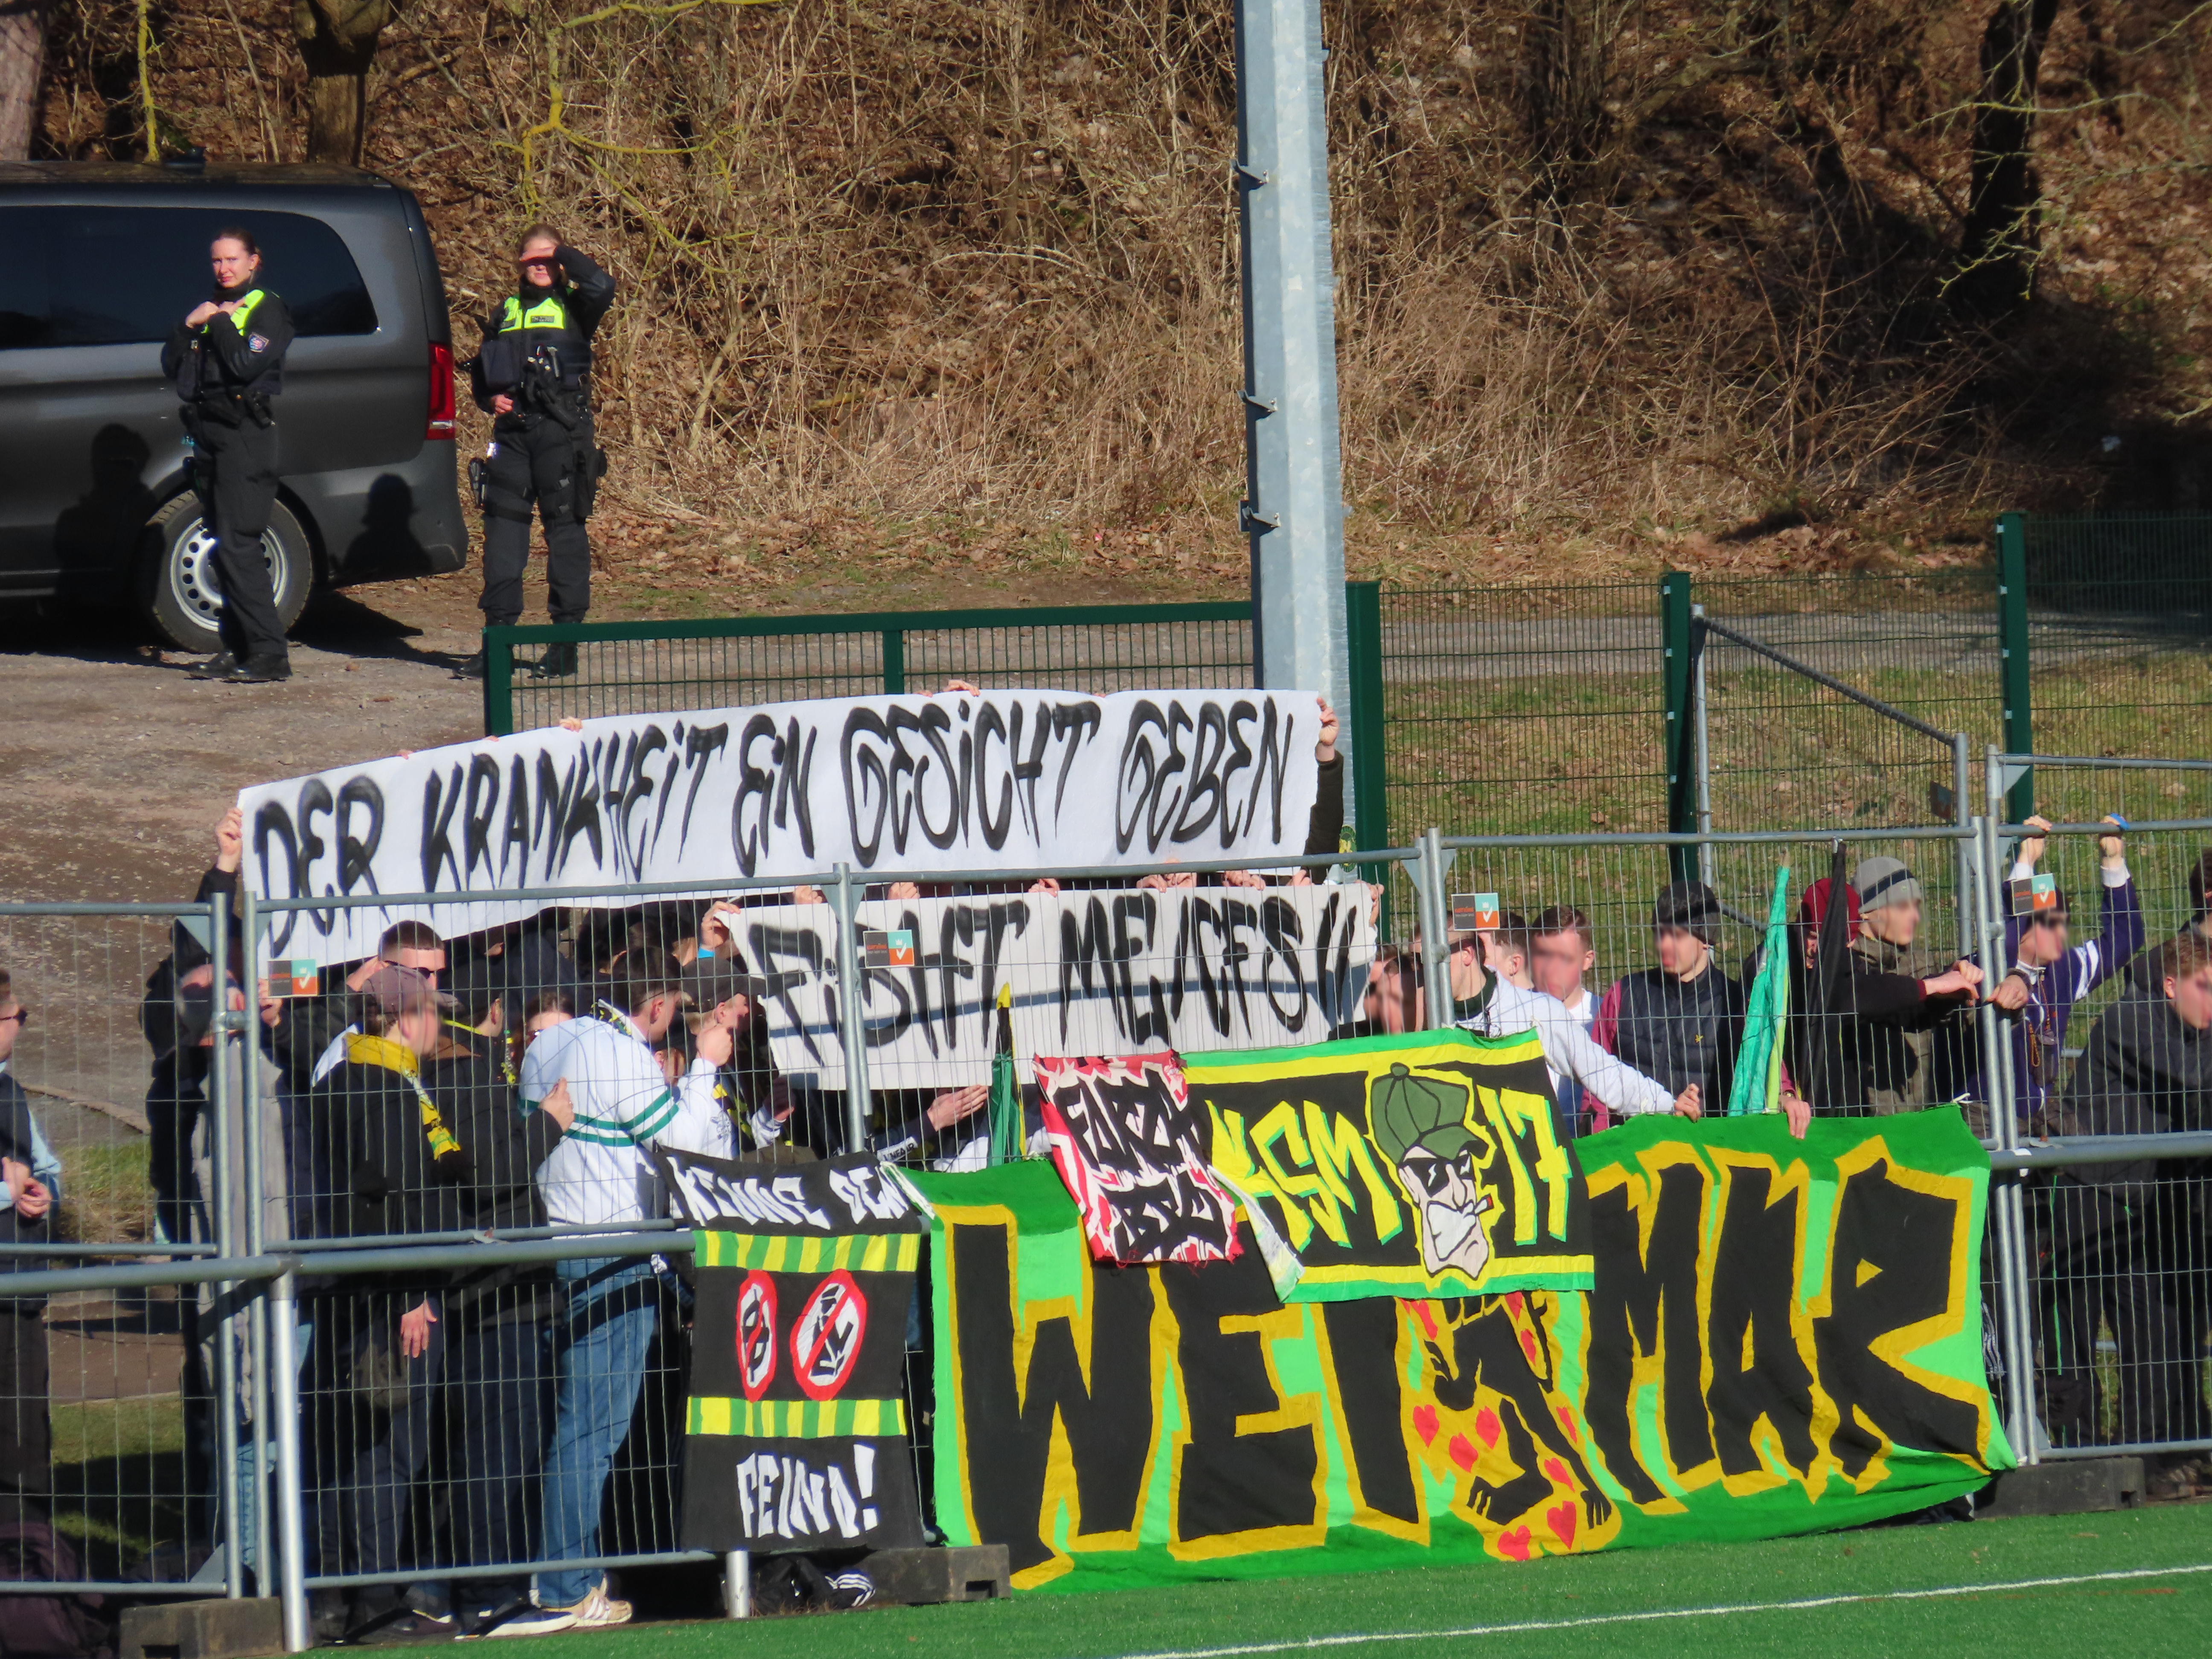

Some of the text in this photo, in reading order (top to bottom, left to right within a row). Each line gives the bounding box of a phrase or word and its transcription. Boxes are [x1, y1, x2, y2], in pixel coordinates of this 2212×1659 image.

[253, 777, 392, 959] DER
[1115, 694, 1293, 854] GEBEN
[666, 1156, 909, 1231] KENNE DEN
[1204, 1084, 1573, 1254] KSM 17
[736, 1443, 879, 1539] FEIND!
